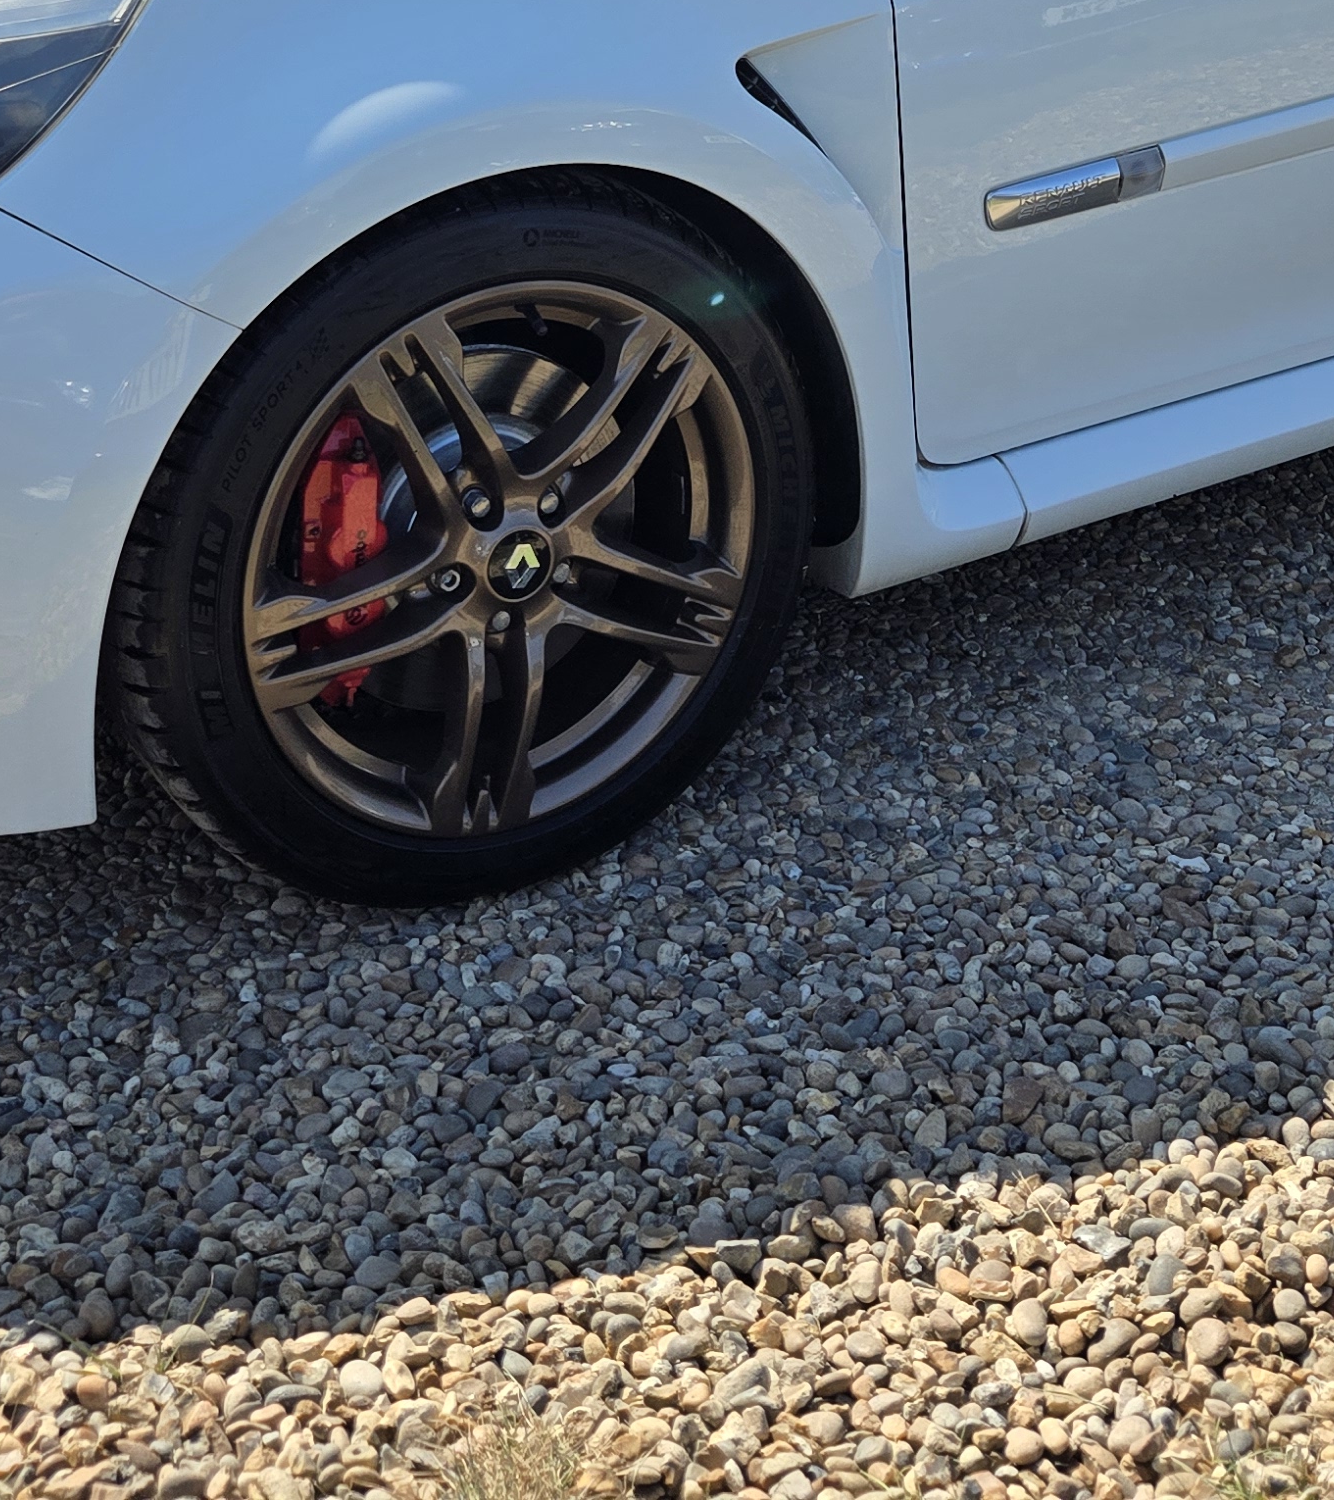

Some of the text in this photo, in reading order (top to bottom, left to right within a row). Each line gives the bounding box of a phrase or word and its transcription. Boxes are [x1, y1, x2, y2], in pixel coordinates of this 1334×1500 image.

[220, 435, 253, 494] PILOT
[252, 368, 295, 432] SPORT
[190, 519, 234, 738] MIHELIN
